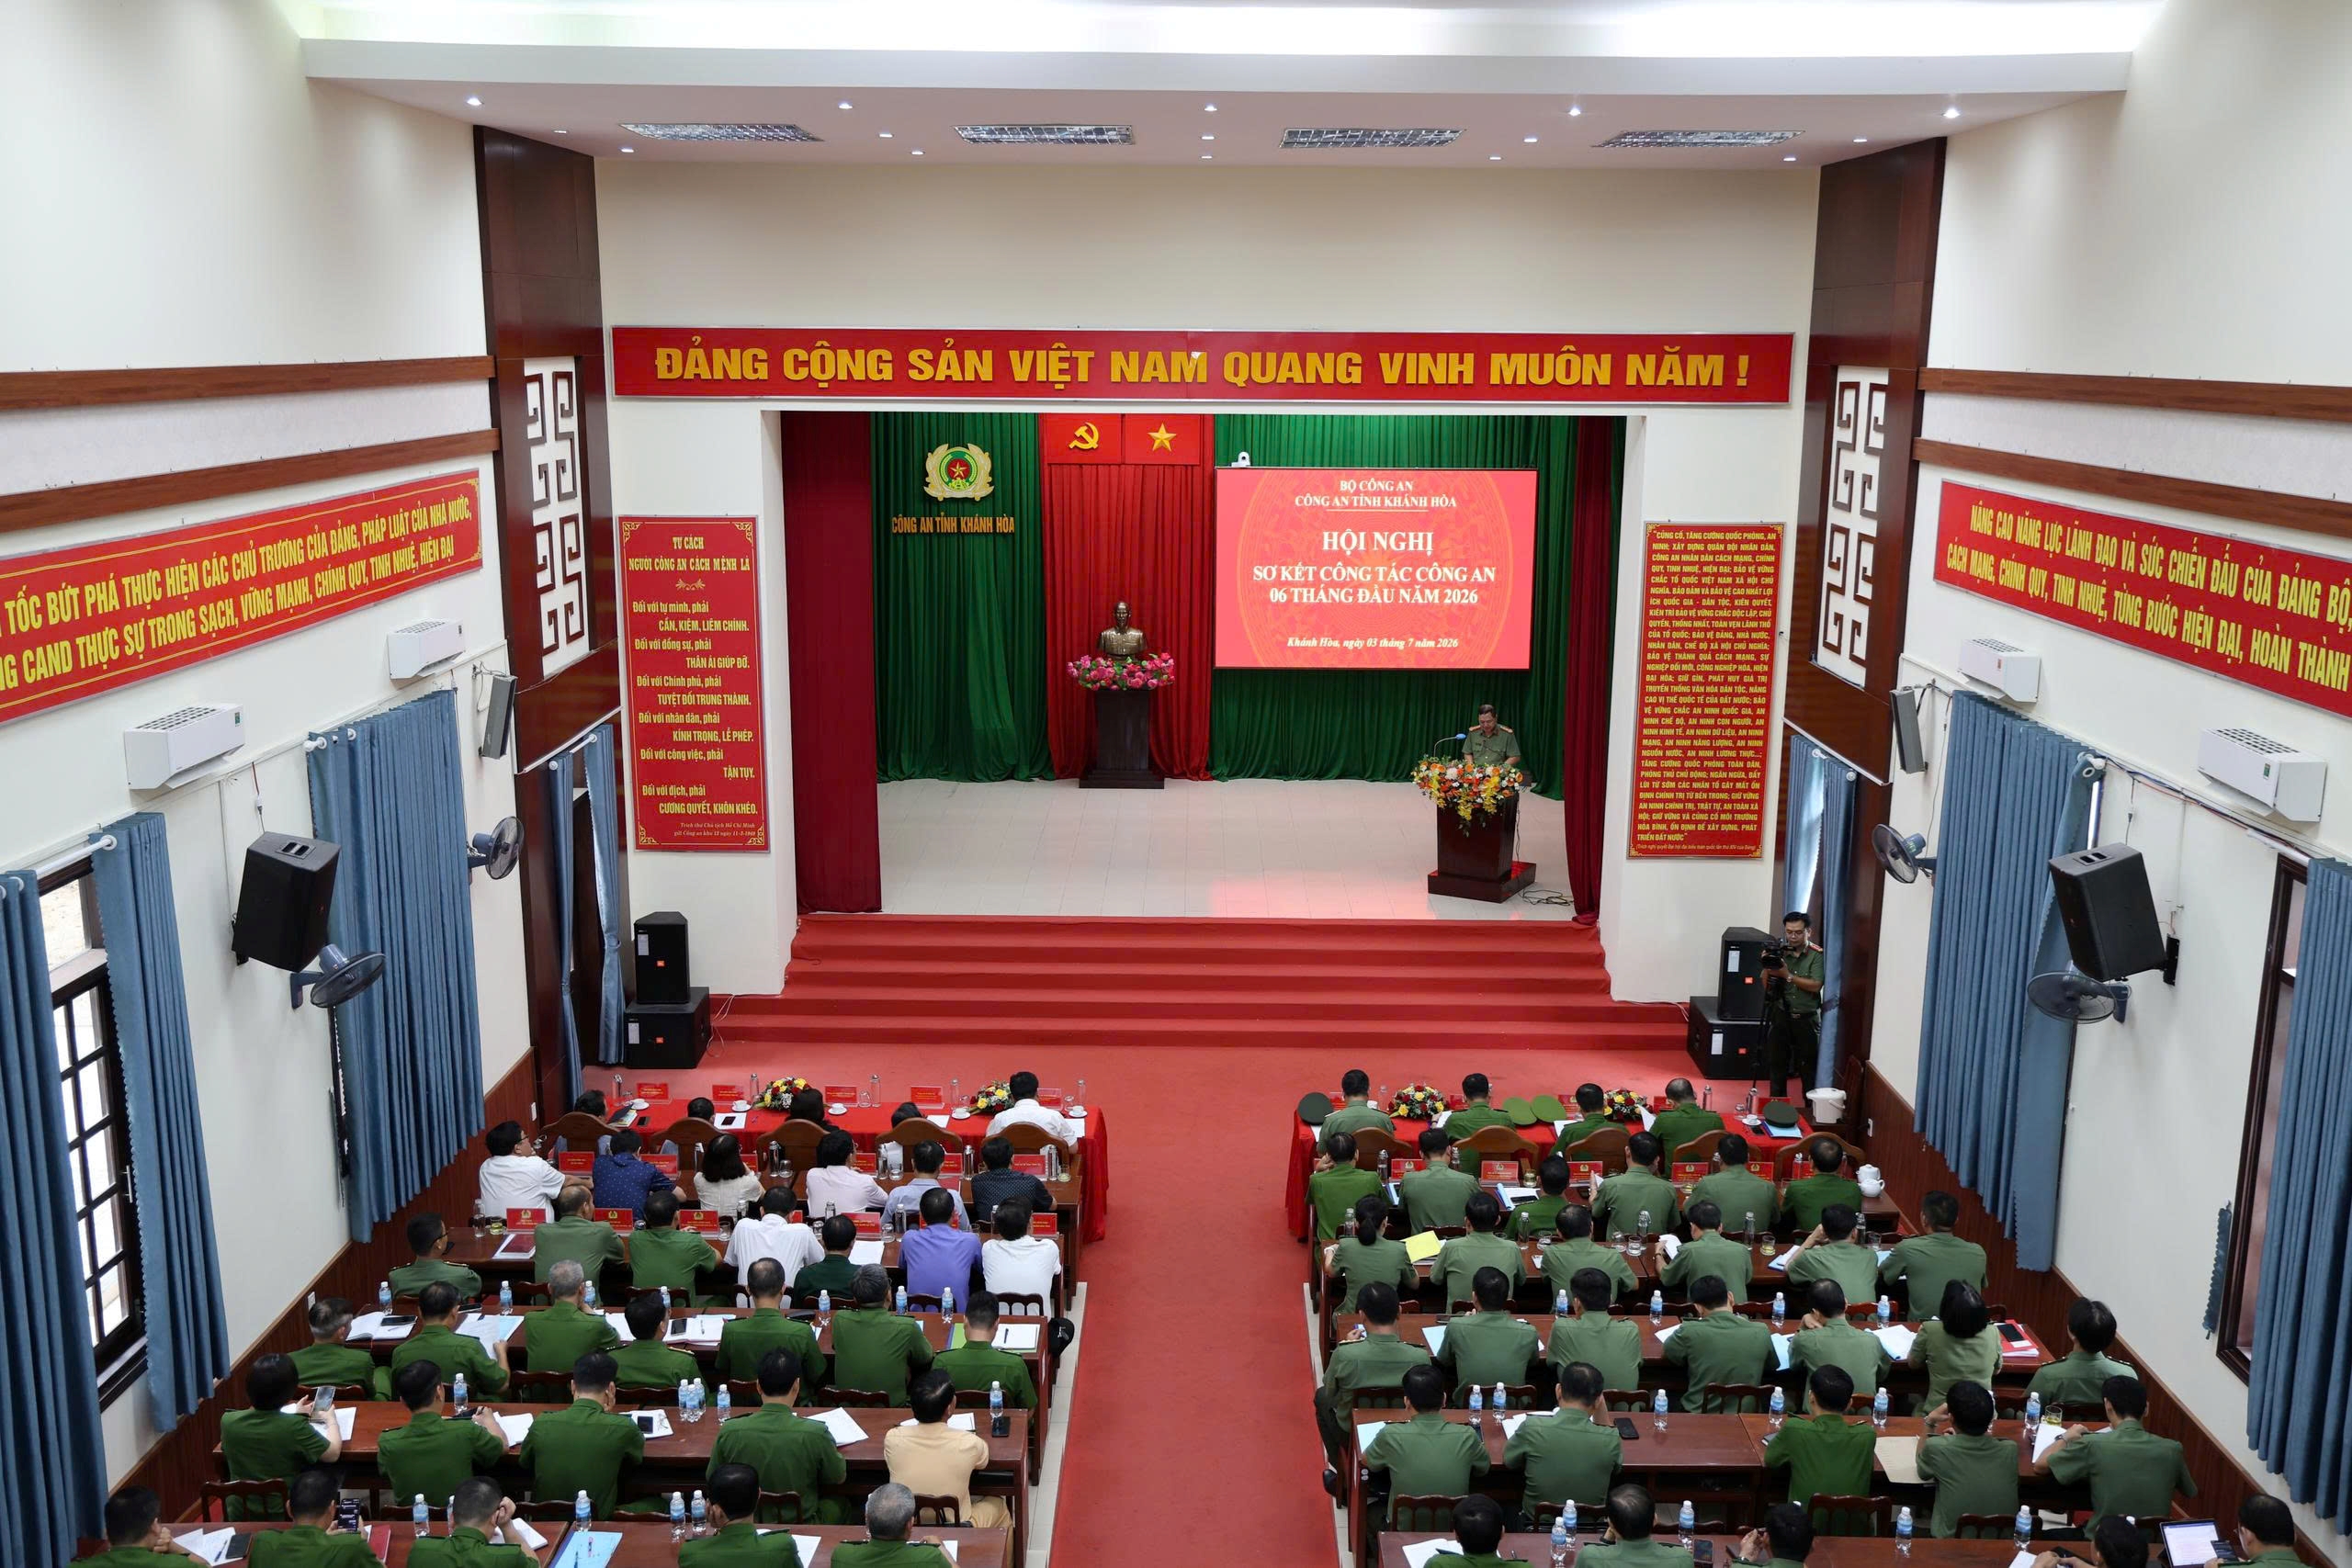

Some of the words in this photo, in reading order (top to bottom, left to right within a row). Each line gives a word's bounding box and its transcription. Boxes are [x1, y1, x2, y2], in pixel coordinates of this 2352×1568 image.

[655, 336, 767, 379] ĐẢNG
[783, 341, 892, 387] CỘNG
[908, 338, 992, 380] SẢN
[1009, 343, 1094, 389] VIỆT
[1111, 351, 1207, 382] NAM
[1224, 351, 1362, 387] QUANG
[1379, 353, 1474, 383] VINH
[1489, 344, 1611, 385] MUÔN
[1626, 346, 1724, 385] NĂM
[1340, 479, 1356, 493] BỘ
[1359, 477, 1394, 491] CÔNG
[1396, 480, 1413, 491] AN
[1295, 492, 1329, 506] CÔNG
[1331, 495, 1349, 506] AN
[1351, 493, 1381, 506] TỈNH
[1384, 493, 1427, 507] KHÁNH
[1430, 493, 1456, 507] HÒA
[892, 514, 917, 533] CÔNG
[920, 516, 933, 532] AN
[934, 512, 956, 533] TỈNH
[960, 514, 992, 533] KHÁNH
[996, 513, 1014, 533] HÒA
[672, 536, 683, 549] TƯ
[684, 534, 704, 549] CÁCH
[1322, 528, 1365, 555] HỘI
[1373, 531, 1433, 556] NGHỊ
[4, 584, 42, 635] TỐC
[46, 581, 79, 625] BỨT
[84, 572, 119, 616] PHÁ
[121, 569, 162, 610] THỰC
[164, 558, 199, 600] HIỆN
[201, 551, 229, 588] CÁC
[232, 539, 256, 581] CHỦ
[258, 537, 304, 573] TRƯƠNG
[306, 525, 328, 560] CỦA
[329, 519, 360, 555] ĐẢNG,
[361, 513, 386, 546] PHÁP
[388, 507, 409, 541] LUẬT
[411, 500, 429, 532] CỦA
[429, 498, 447, 527] NHÀ
[447, 493, 471, 524] NƯỚC,
[1970, 500, 1994, 536] NÂNG
[1996, 511, 2013, 540] CAO
[2015, 511, 2041, 547] NĂNG
[2043, 521, 2063, 558] LỰC
[2064, 520, 2092, 560] LÃNH
[2095, 533, 2117, 571] ĐẠO
[2120, 532, 2135, 572] VÀ
[2139, 536, 2164, 579] SỨC
[2167, 536, 2206, 589] CHIẾN
[2210, 543, 2238, 597] ĐẤU
[2243, 555, 2271, 606] CỦA
[2277, 562, 2321, 618] ĐẢNG
[1253, 565, 1277, 581] SƠ
[1280, 561, 1317, 581] KẾT
[1319, 561, 1372, 581] CÔNG
[1374, 562, 1412, 581] TÁC
[1415, 561, 1467, 581] CÔNG
[1470, 567, 1496, 581] AN
[1269, 587, 1287, 603] 06
[1290, 583, 1353, 603] THÁNG
[1356, 583, 1395, 603] ĐẦU
[1398, 584, 1440, 603] NĂM
[1443, 588, 1477, 604] 2026
[22, 640, 73, 683] CAND
[75, 626, 119, 670] THỰC
[123, 617, 144, 660] SỰ
[147, 608, 196, 649] TRONG
[198, 597, 238, 637] SẠCH,
[240, 586, 273, 621] VỮNG
[275, 576, 312, 613] MẠNH,
[314, 564, 346, 598] CHÍNH
[347, 558, 368, 590] QUY,
[369, 552, 391, 581] TINH
[392, 540, 418, 574] NHUỆ,
[419, 536, 439, 568] HIỆN
[440, 534, 454, 562] ĐẠI
[632, 600, 646, 612] Đối
[646, 601, 659, 613] với
[659, 602, 668, 615] tự
[668, 601, 691, 614] mình,
[691, 600, 708, 614] phải
[1946, 536, 1968, 572] CÁCH
[1969, 549, 1995, 585] MẠNG,
[1998, 553, 2026, 592] CHÍNH
[2028, 566, 2048, 603] QUY,
[2052, 573, 2075, 606] TINH
[2077, 579, 2107, 623] NHUỆ,
[2113, 583, 2142, 627] TỪNG
[2144, 594, 2177, 638] BƯỚC
[2181, 605, 2213, 653] HIỆN
[2217, 619, 2243, 663] ĐẠI,
[2249, 623, 2291, 673] HOÀN
[2297, 636, 2350, 692] THÀNH
[658, 617, 677, 632] CẦN,
[678, 617, 701, 633] KIỆM,
[702, 617, 721, 631] LIÊM
[722, 617, 749, 631] CHÍNH.
[634, 637, 648, 649] Đối
[649, 638, 661, 649] với
[662, 637, 681, 650] đồng
[682, 639, 694, 651] sự,
[694, 637, 711, 650] phải
[1287, 637, 1317, 647] Khánh
[1318, 637, 1340, 648] Hòa,
[1342, 637, 1364, 649] ngày
[1366, 637, 1377, 647] 03
[1379, 637, 1405, 649] tháng
[1408, 637, 1413, 647] 7
[1414, 638, 1435, 647] năm
[1436, 637, 1458, 647] 2026
[685, 654, 707, 668] THÂN
[707, 655, 716, 668] ÁI
[717, 655, 735, 668] GIÚP
[736, 654, 750, 668] ĐỠ.
[723, 764, 739, 780] TẬN
[739, 767, 754, 780] TỤY.
[642, 784, 654, 795] Đối
[656, 784, 667, 795] với
[668, 784, 687, 797] địch,
[688, 784, 706, 796] phải
[659, 802, 685, 813] CƯƠNG
[686, 799, 711, 814] QUYẾT,
[713, 801, 734, 814] KHÔN
[735, 801, 757, 814] KHÉO.
